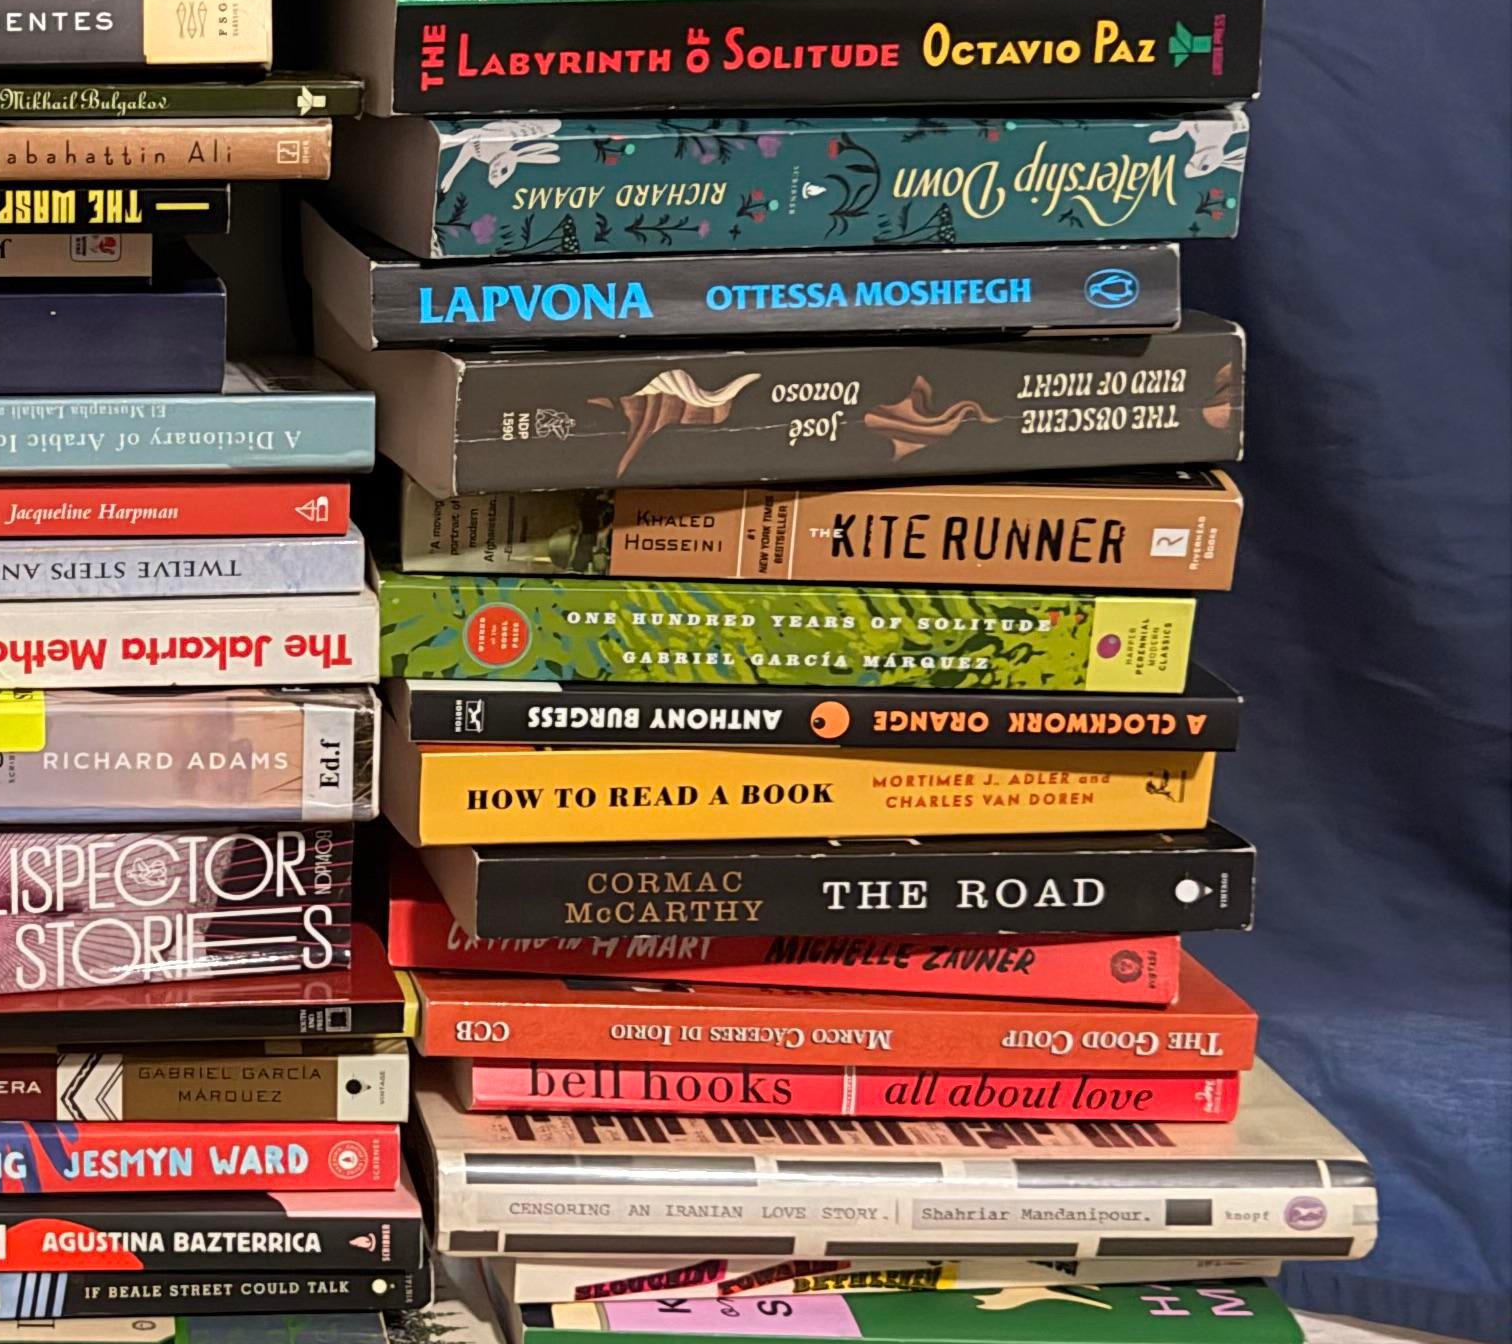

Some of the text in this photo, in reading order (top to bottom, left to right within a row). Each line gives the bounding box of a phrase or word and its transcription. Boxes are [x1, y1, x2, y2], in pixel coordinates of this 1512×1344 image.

[420, 283, 653, 323] LAPVONA
[502, 412, 514, 440] 1590
[518, 414, 529, 439] NDP
[5, 503, 178, 524] Jacqueline Harpman
[566, 611, 1051, 632] ONE HUNDRED YEARS OF SOLITUDE
[1136, 619, 1149, 675] PERENNIAL
[1159, 623, 1172, 671] CLASSICS
[44, 752, 287, 769] RICHARD ADAMS
[873, 771, 1110, 787] MORTIMER J. ADLER and
[468, 784, 832, 809] HOW TO READ A BOOK
[886, 793, 1093, 808] CHARLES VAN DOREN
[823, 879, 1104, 909] THE ROAD
[509, 1203, 610, 1216] CENSORING
[628, 1205, 650, 1216] AN
[666, 1205, 742, 1218] IRANIAN
[762, 1207, 806, 1219] LOVE
[42, 1232, 321, 1254] AGUSTINA BAZTERRICA
[84, 1280, 351, 1299] IF BEALE STREET COULD TALK
